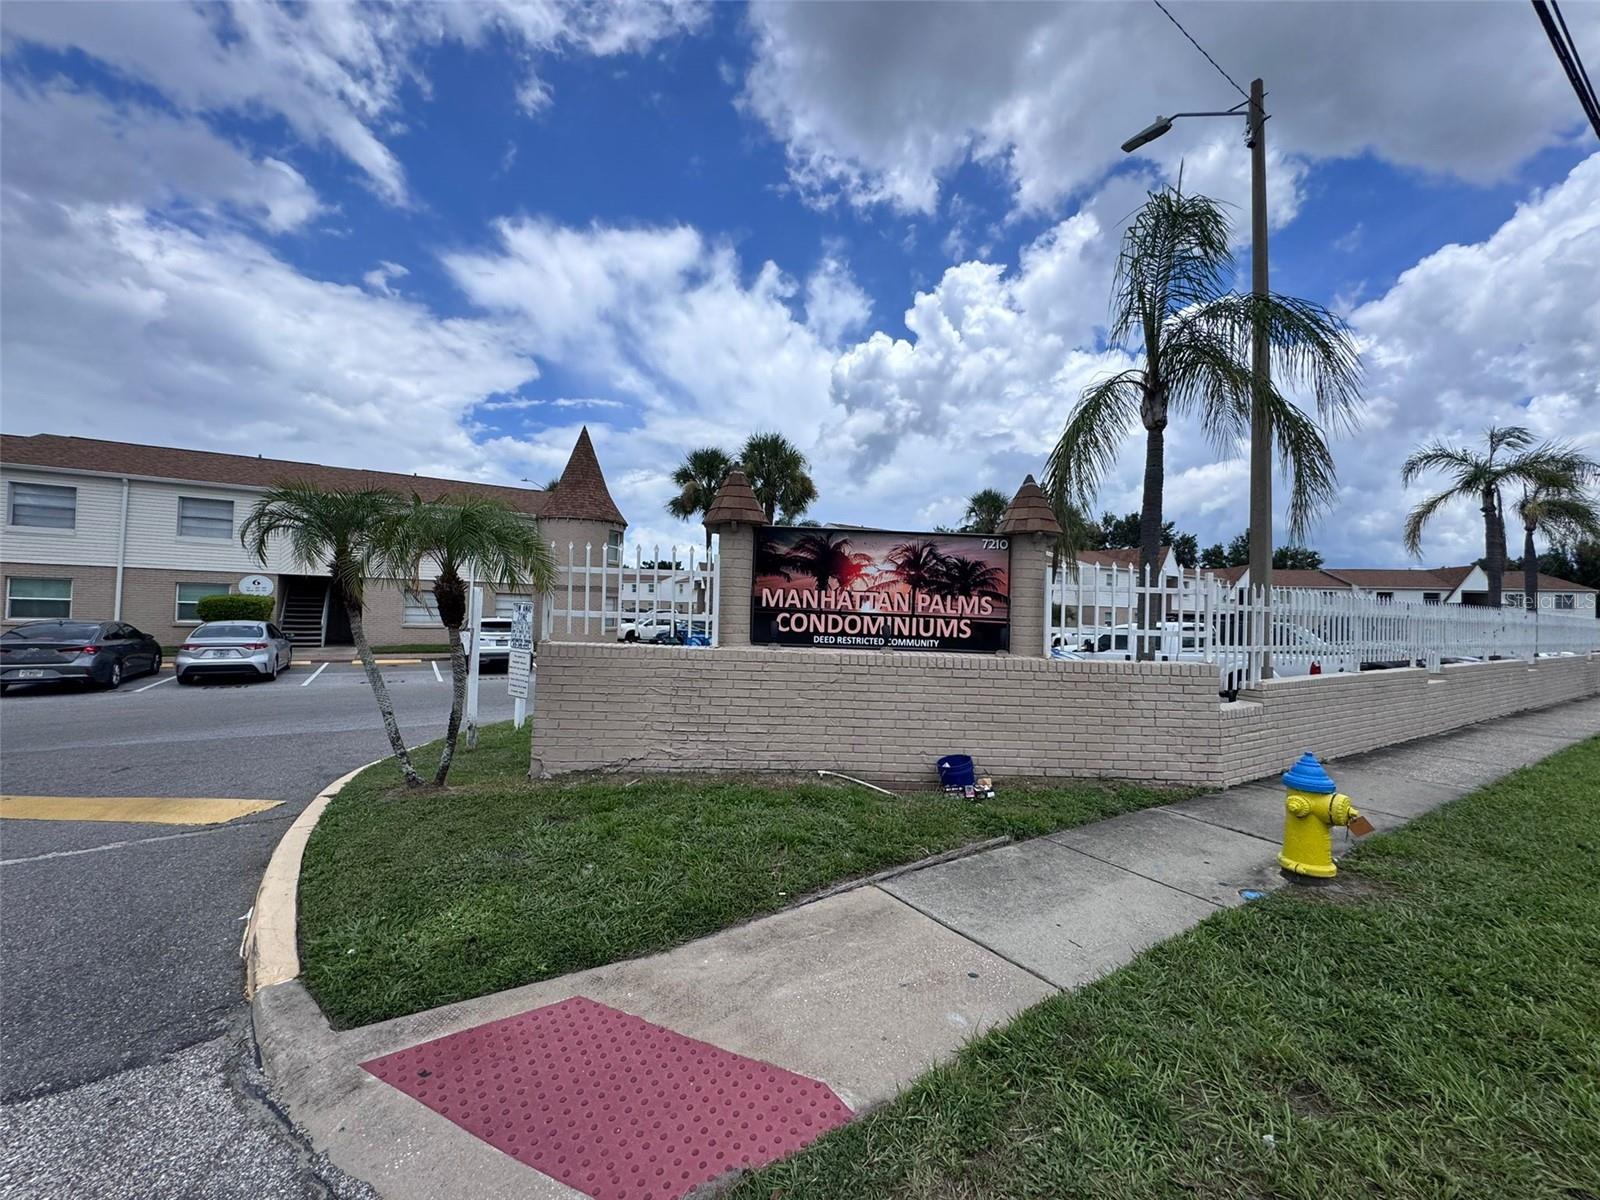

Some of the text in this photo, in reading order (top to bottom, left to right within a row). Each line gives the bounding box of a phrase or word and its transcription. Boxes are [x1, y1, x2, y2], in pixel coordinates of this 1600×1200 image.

[982, 538, 1008, 550] 7210
[761, 587, 993, 616] MANHATTAN PALMS
[776, 612, 972, 639] CONDOMINIUMS
[813, 635, 835, 644] DEED
[837, 636, 885, 646] RESTRICTED
